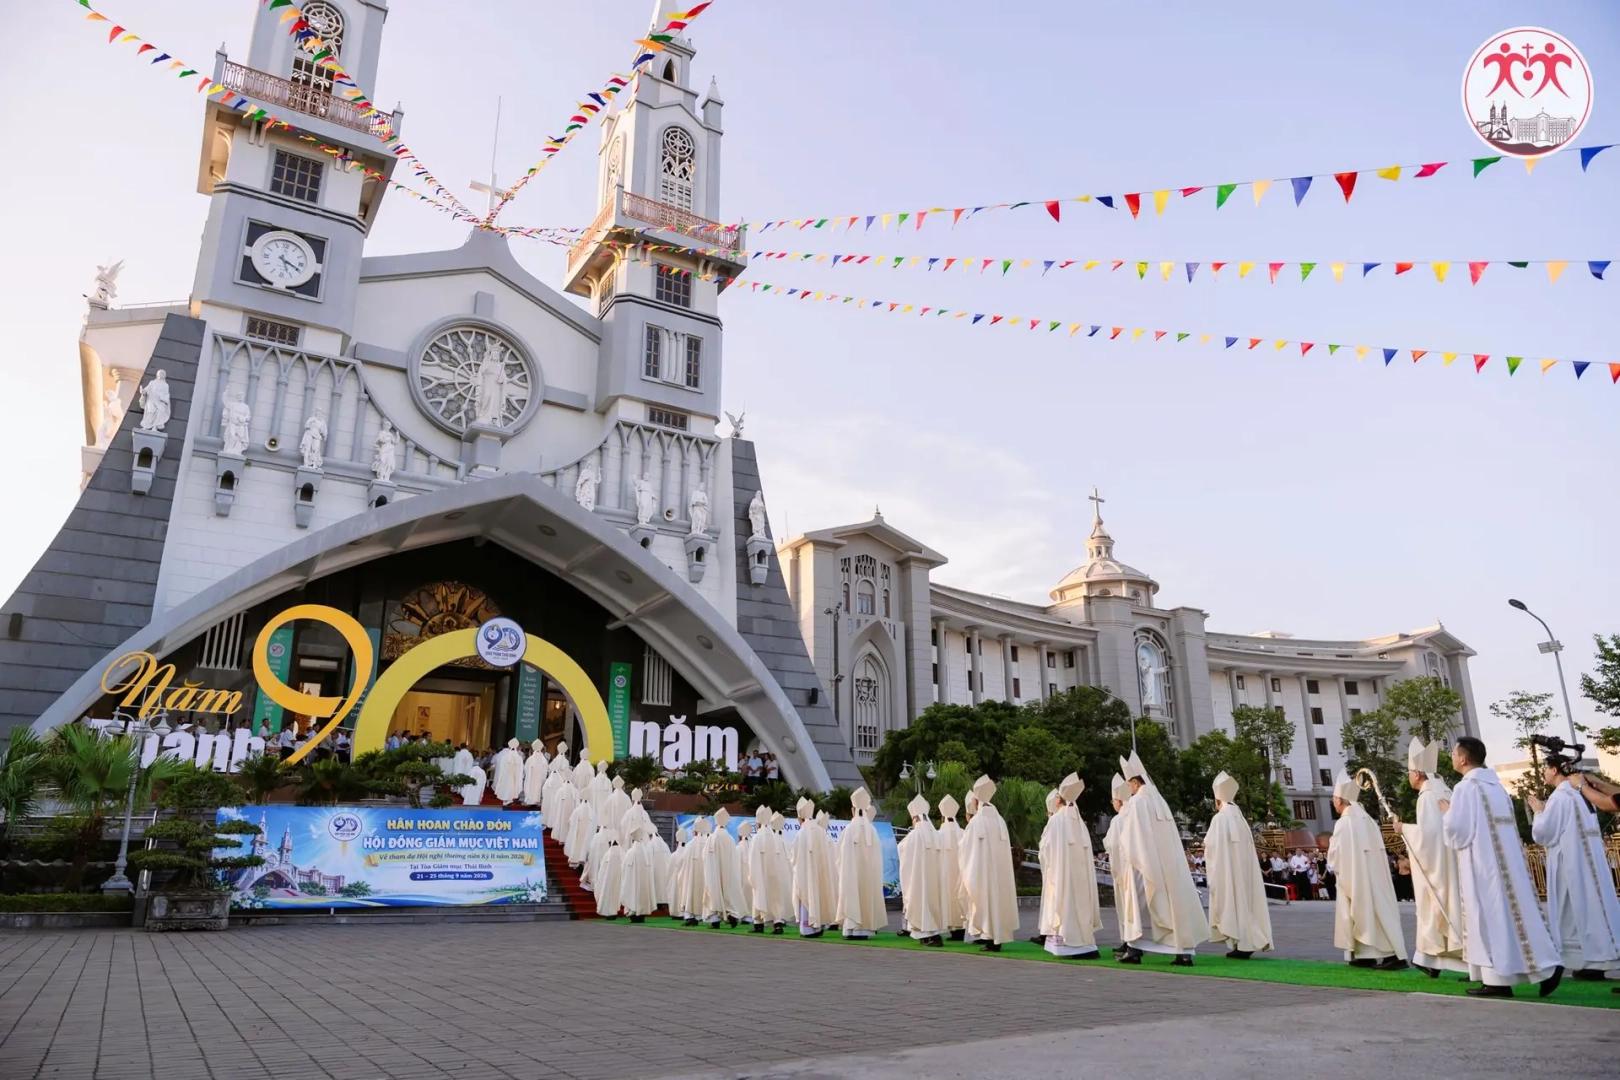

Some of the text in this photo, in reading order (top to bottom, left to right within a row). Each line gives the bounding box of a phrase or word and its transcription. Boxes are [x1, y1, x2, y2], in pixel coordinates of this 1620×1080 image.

[101, 651, 243, 720] Năm
[629, 714, 739, 772] năm
[387, 818, 512, 831] HÂN HOAN CHÀO ĐÓN
[363, 835, 386, 850] HỘI
[425, 835, 456, 848] GIÁM
[458, 837, 483, 849] MỤC
[484, 836, 510, 850] VIỆT
[512, 838, 538, 849] NAM
[437, 872, 454, 880] tháng
